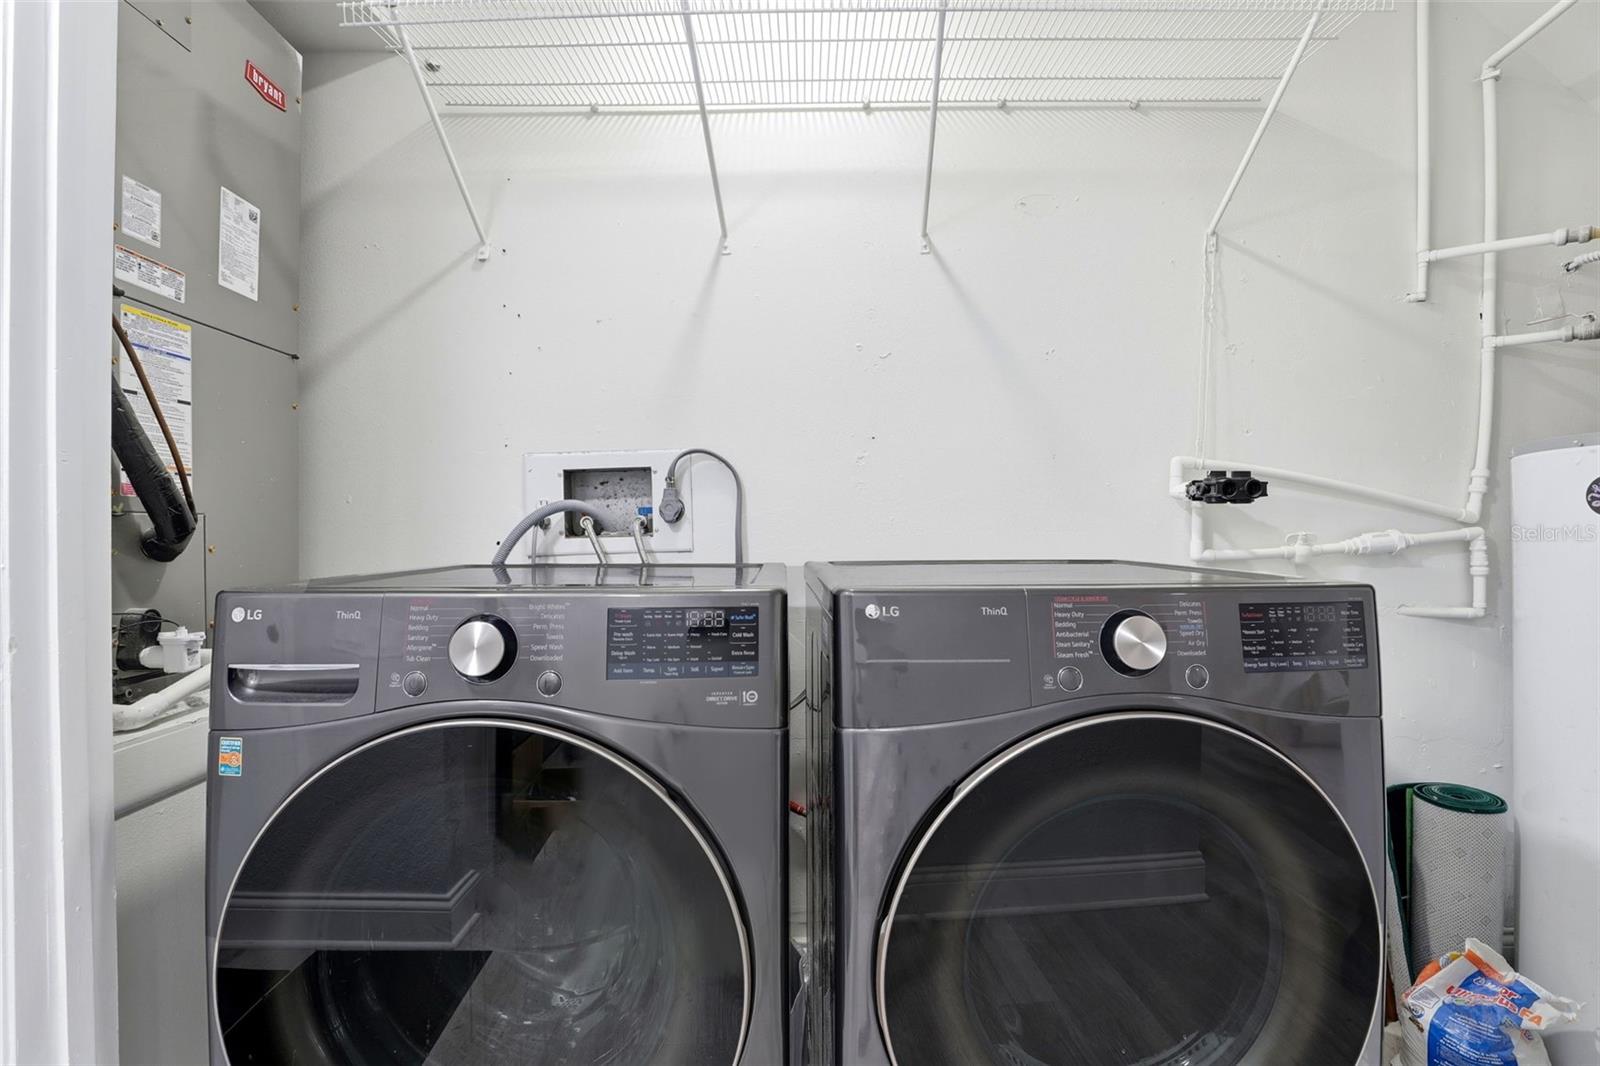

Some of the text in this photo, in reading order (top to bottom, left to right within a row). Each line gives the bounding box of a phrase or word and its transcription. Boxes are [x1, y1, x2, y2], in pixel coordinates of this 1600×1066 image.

[252, 68, 283, 105] bryant
[247, 608, 264, 621] LG
[335, 609, 362, 620] ThinQ
[882, 606, 900, 617] LG
[980, 606, 1008, 616] ThinQ
[1054, 611, 1084, 619] Heavy Duty
[409, 614, 439, 622] Heavy Duty
[408, 624, 429, 632] Bedding
[1055, 621, 1077, 629] Bedding
[408, 633, 428, 642] Sanitary
[1179, 629, 1204, 638] Speed Dry
[530, 643, 548, 651] Speed
[1056, 640, 1071, 648] Steam
[1056, 651, 1074, 659] Steam
[1177, 649, 1207, 657] Downloaded
[529, 654, 564, 662] Downloaded
